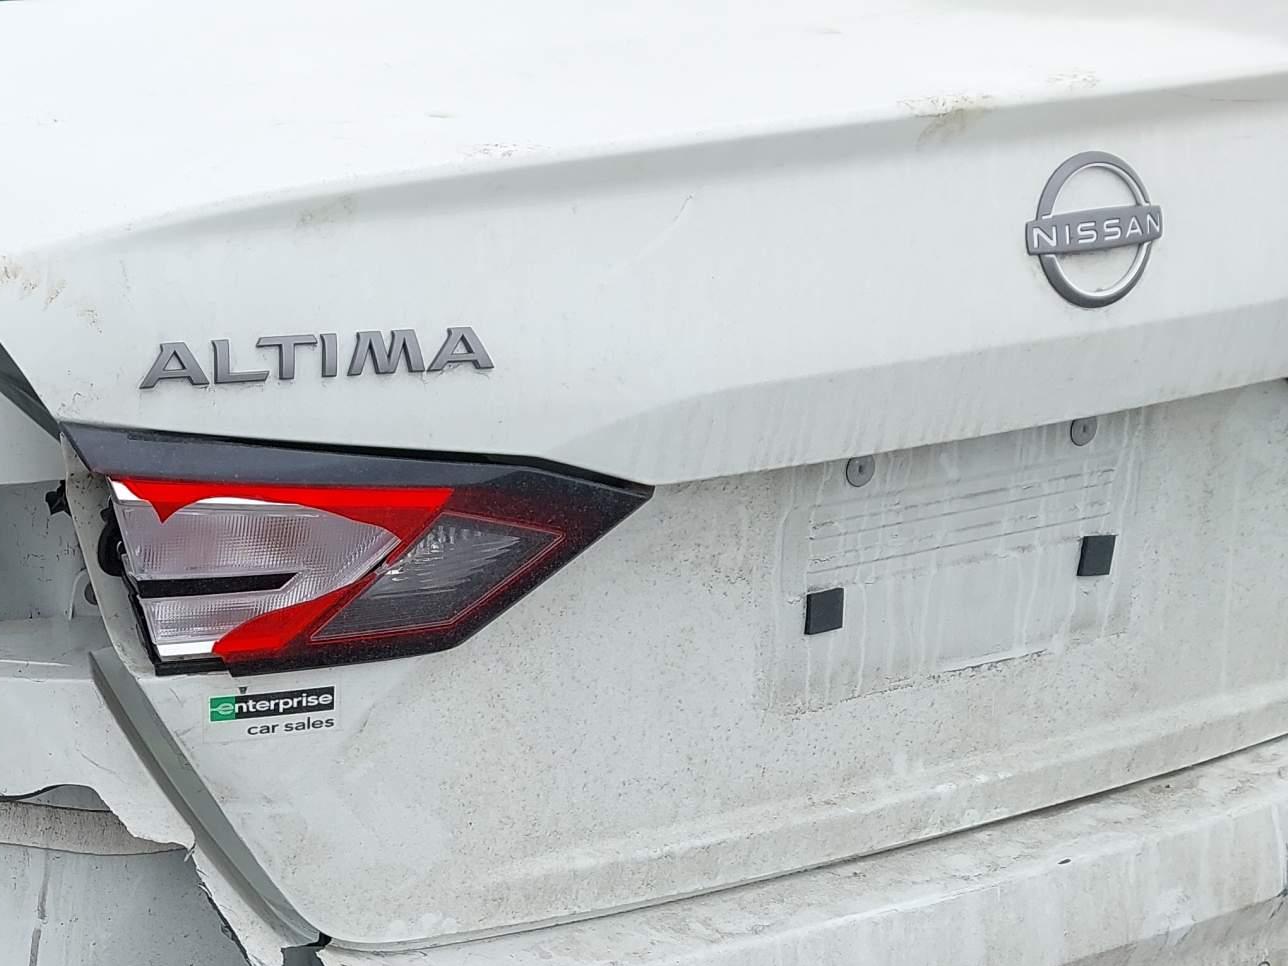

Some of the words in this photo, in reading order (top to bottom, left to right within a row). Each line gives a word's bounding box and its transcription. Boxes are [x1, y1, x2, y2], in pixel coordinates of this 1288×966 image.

[1032, 213, 1161, 249] NISSAN
[139, 326, 495, 390] ALTIMA
[212, 693, 333, 715] enterprise
[247, 723, 279, 735] car
[284, 717, 335, 732] sales
